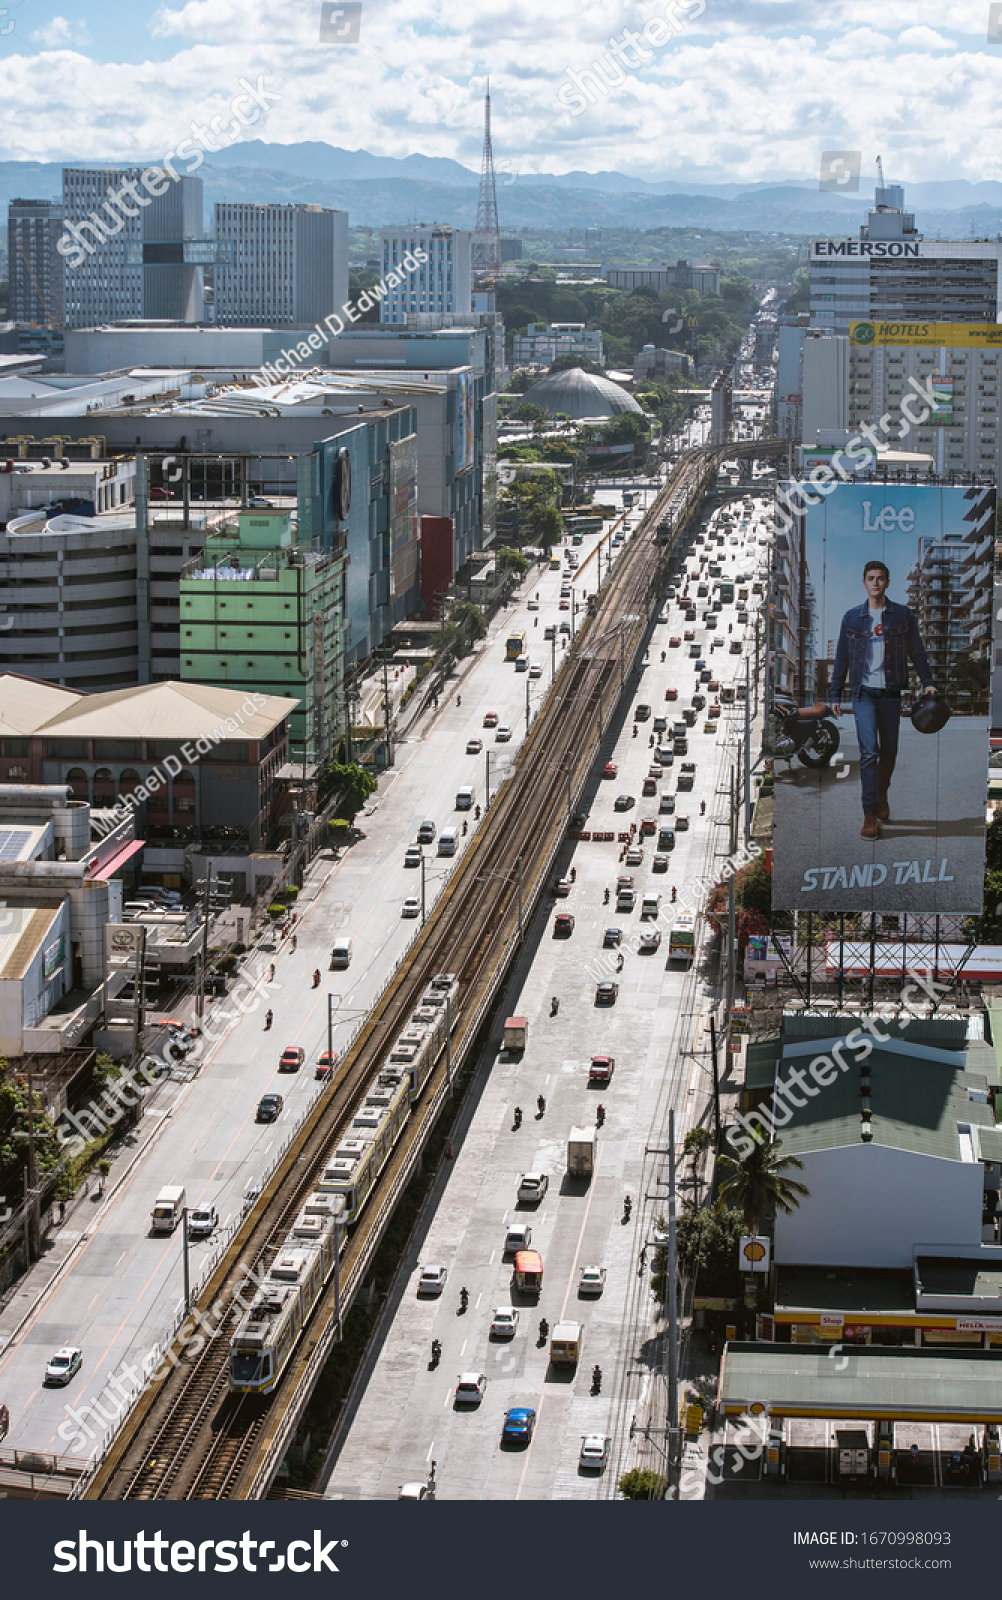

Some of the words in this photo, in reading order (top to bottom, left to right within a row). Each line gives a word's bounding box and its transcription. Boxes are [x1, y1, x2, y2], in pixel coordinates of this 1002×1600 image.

[815, 242, 919, 256] EMERSON
[879, 324, 930, 336] HOTELS
[862, 500, 915, 532] Lee
[801, 863, 888, 892] STAND
[892, 857, 955, 885] TALL
[822, 1317, 843, 1325] Shop
